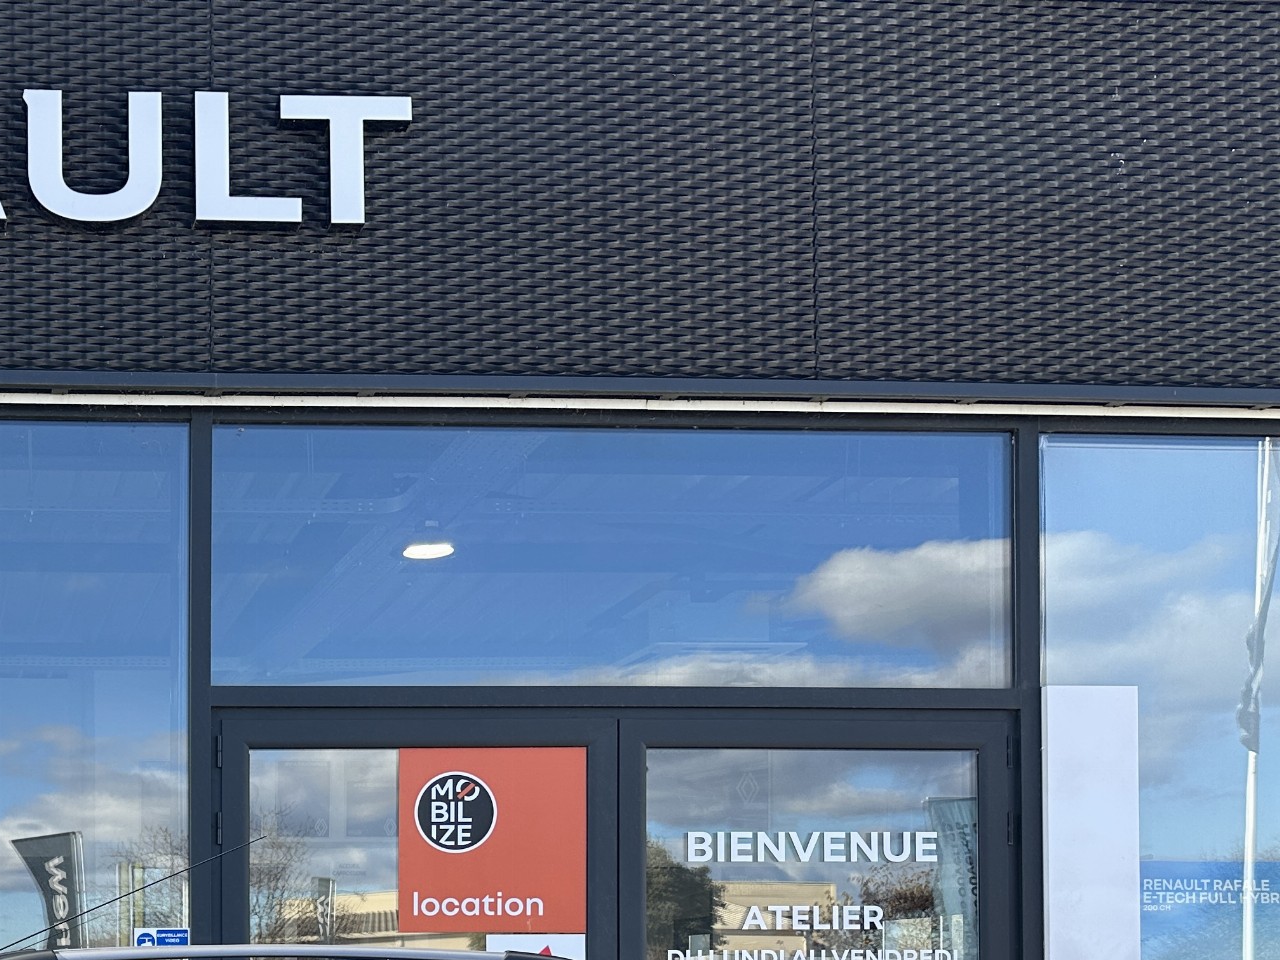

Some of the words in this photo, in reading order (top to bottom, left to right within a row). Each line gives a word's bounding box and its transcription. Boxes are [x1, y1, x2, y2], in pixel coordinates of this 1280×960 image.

[431, 801, 472, 823] BIL
[431, 824, 472, 846] IZE
[687, 831, 938, 863] BIENVENUE
[1143, 879, 1211, 892] RENAULT
[413, 891, 544, 917] location
[1143, 892, 1196, 905] E-TECH
[1200, 892, 1237, 904] FULL
[742, 905, 884, 930] ATELIER
